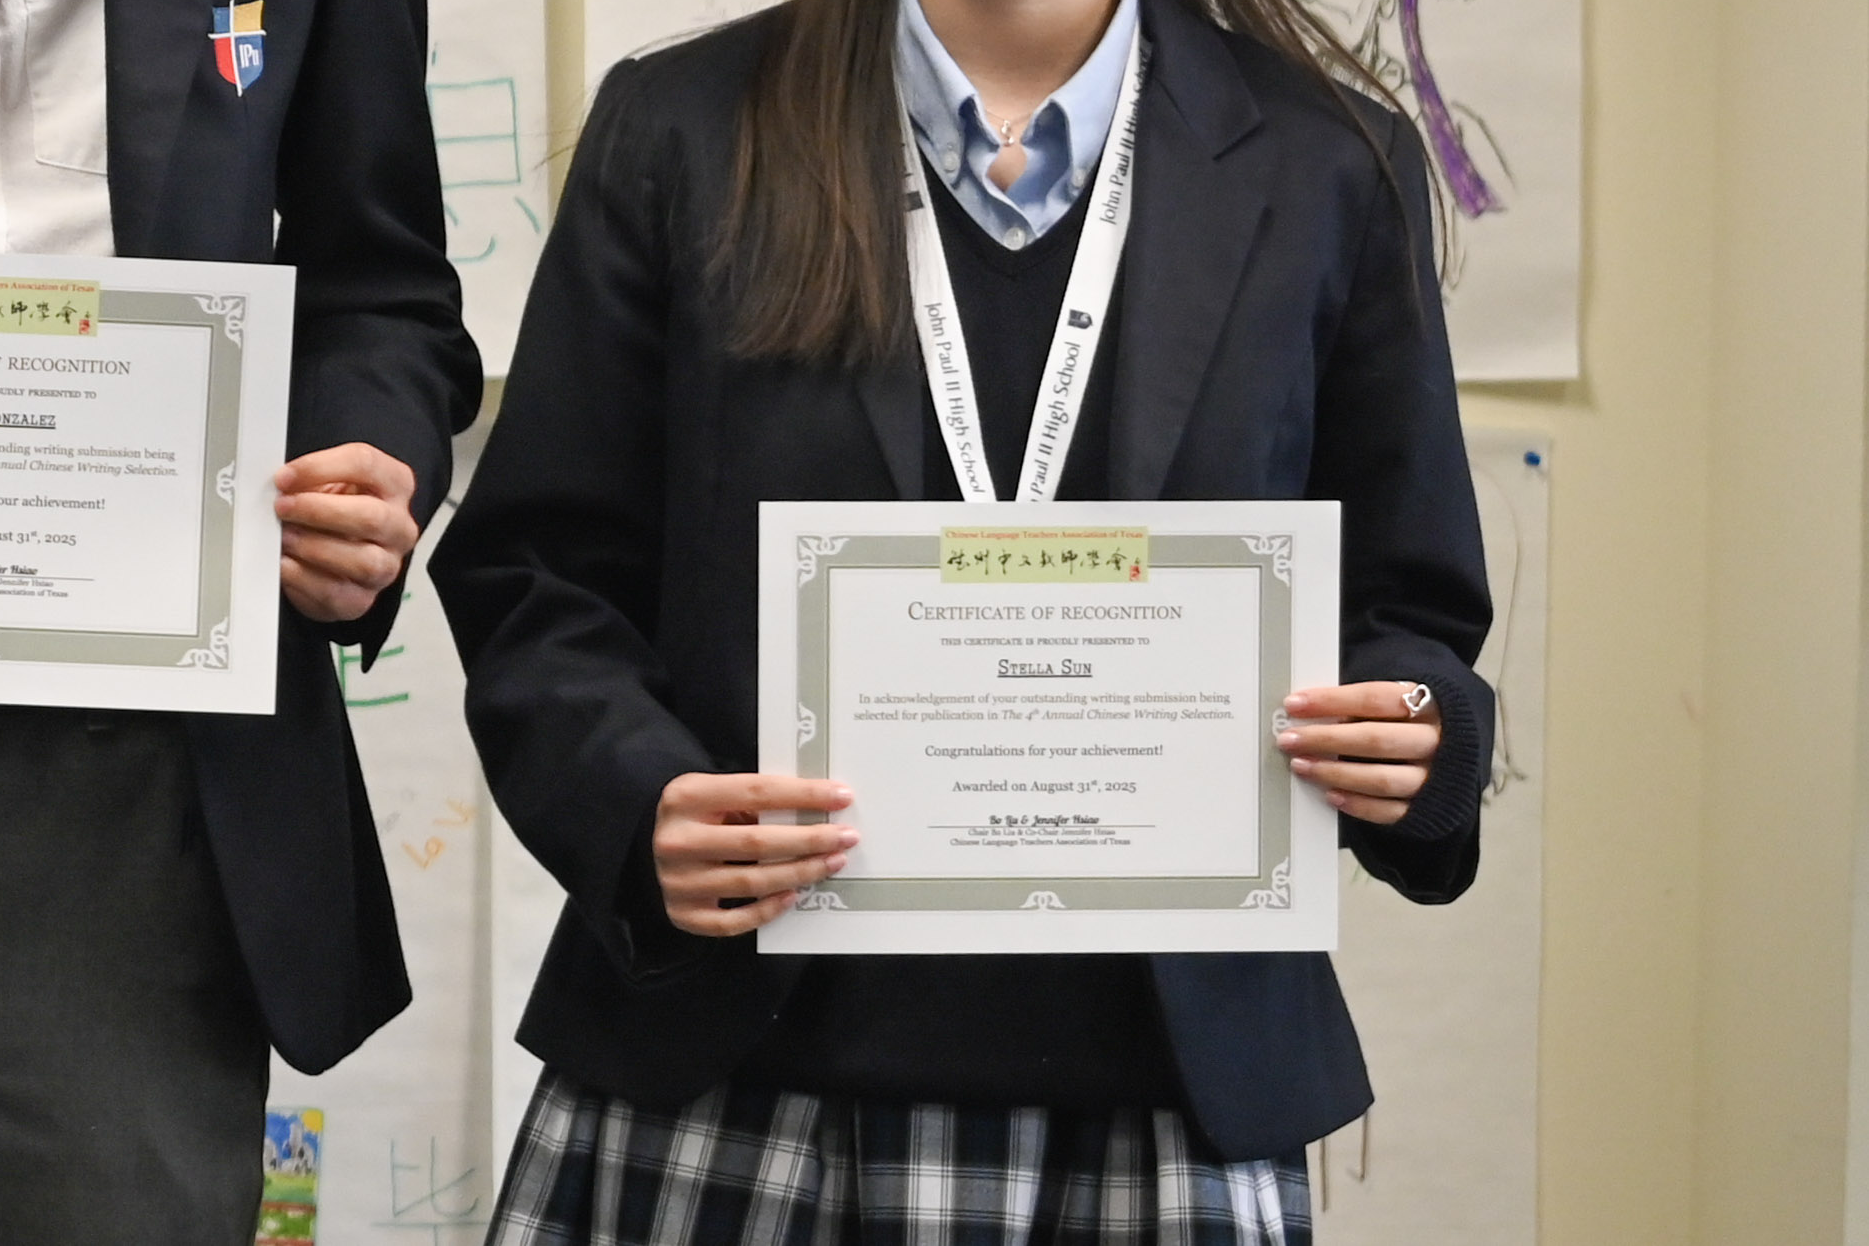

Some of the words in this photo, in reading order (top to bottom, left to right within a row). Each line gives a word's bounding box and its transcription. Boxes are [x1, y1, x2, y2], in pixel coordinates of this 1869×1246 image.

[1109, 151, 1131, 187] Paul
[1099, 192, 1122, 225] John
[924, 302, 947, 337] John
[936, 341, 959, 375] Paul
[1053, 341, 1081, 397] School
[945, 380, 961, 391] II
[945, 397, 970, 437] High
[1042, 400, 1069, 440] High
[1038, 443, 1054, 456] II
[957, 441, 986, 493] School
[1030, 458, 1049, 496] Paul
[21, 494, 106, 510] achievement!
[44, 533, 77, 547] 2025
[924, 743, 1026, 760] Congratulations
[1028, 744, 1047, 757] for
[1048, 747, 1079, 759] your
[1080, 743, 1164, 757] achievement!
[952, 779, 1009, 793] Awarded
[1010, 782, 1028, 792] on
[1029, 780, 1074, 795] August
[1104, 781, 1137, 794] 2025
